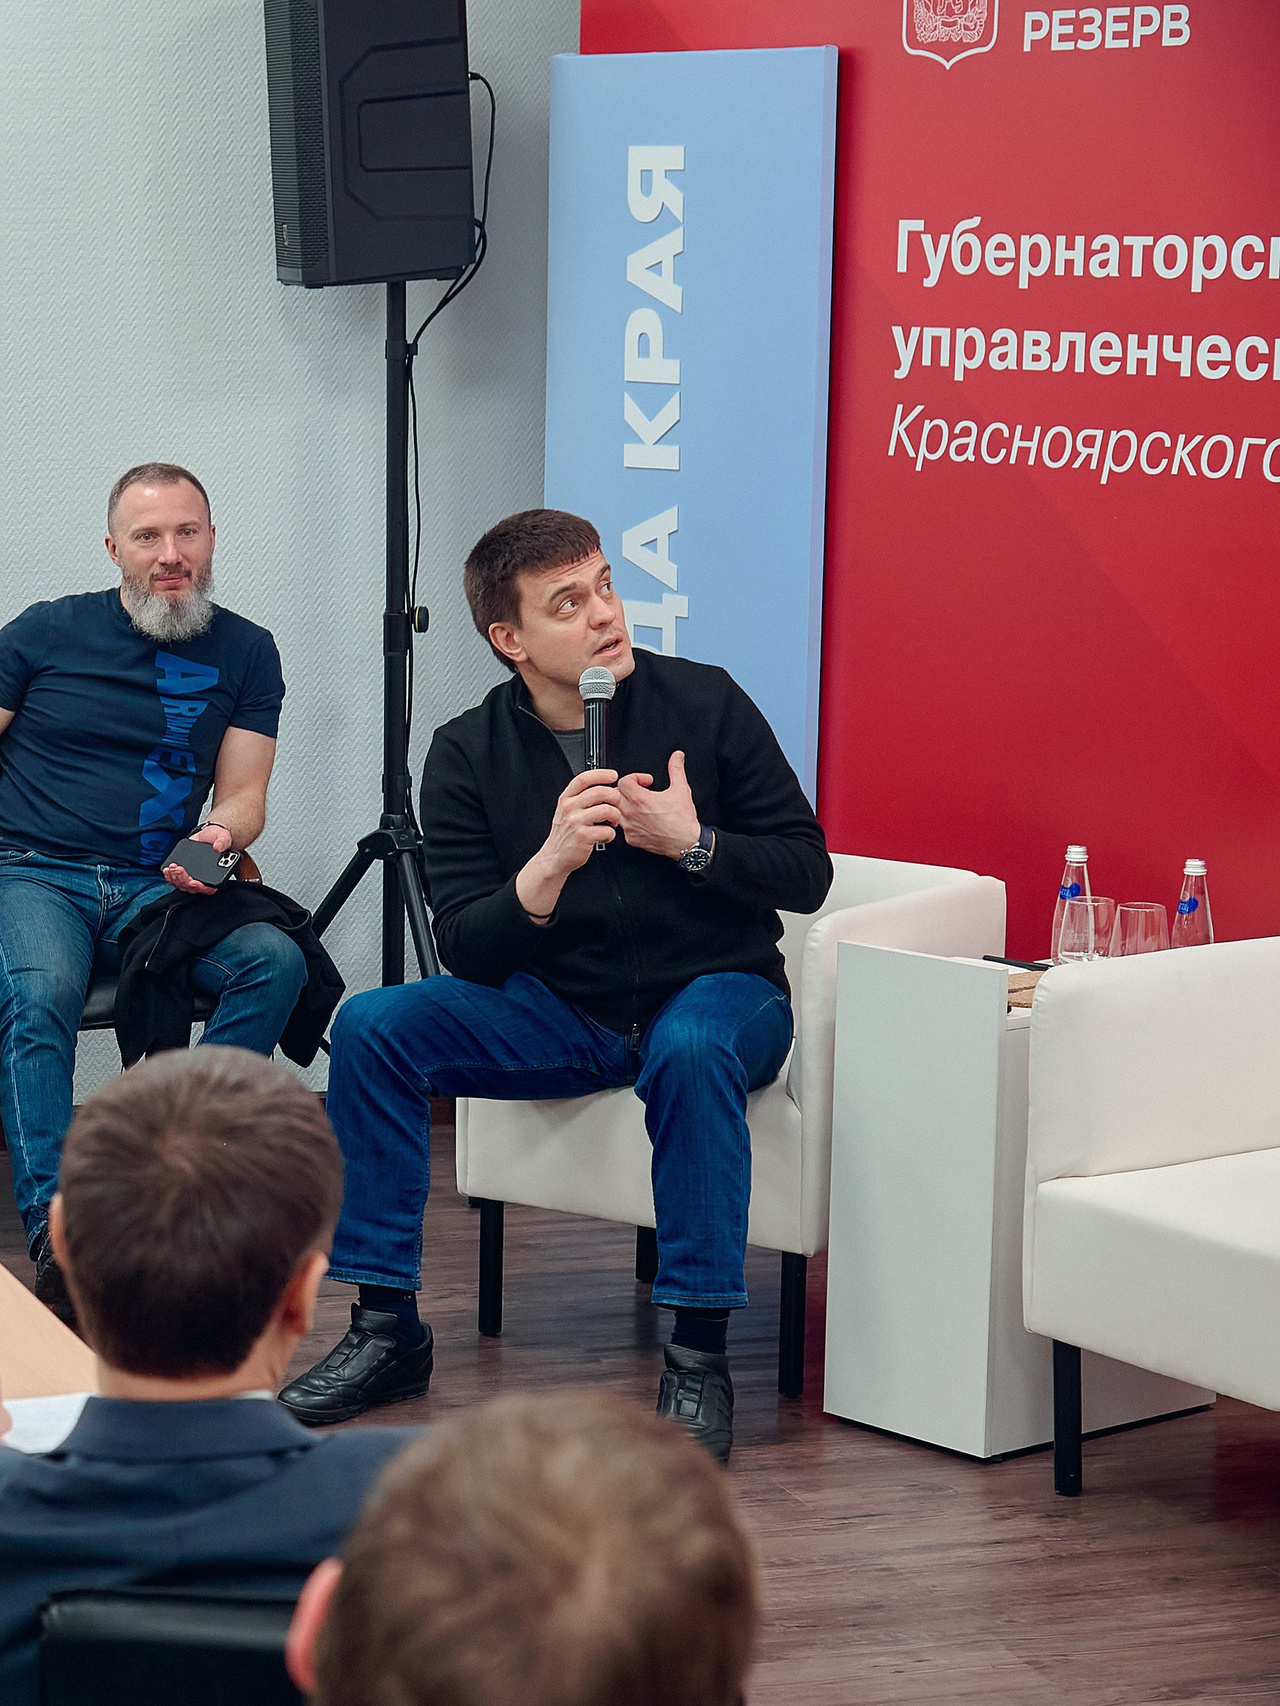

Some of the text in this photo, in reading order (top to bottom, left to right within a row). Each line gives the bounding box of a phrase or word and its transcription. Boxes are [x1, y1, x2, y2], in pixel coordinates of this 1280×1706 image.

[1023, 4, 1191, 52] РЕЗЕРВ
[623, 145, 685, 471] КРАЯ
[891, 325, 1280, 382] управленчес
[887, 403, 1280, 485] Красноярского
[155, 650, 219, 746] ARMANI
